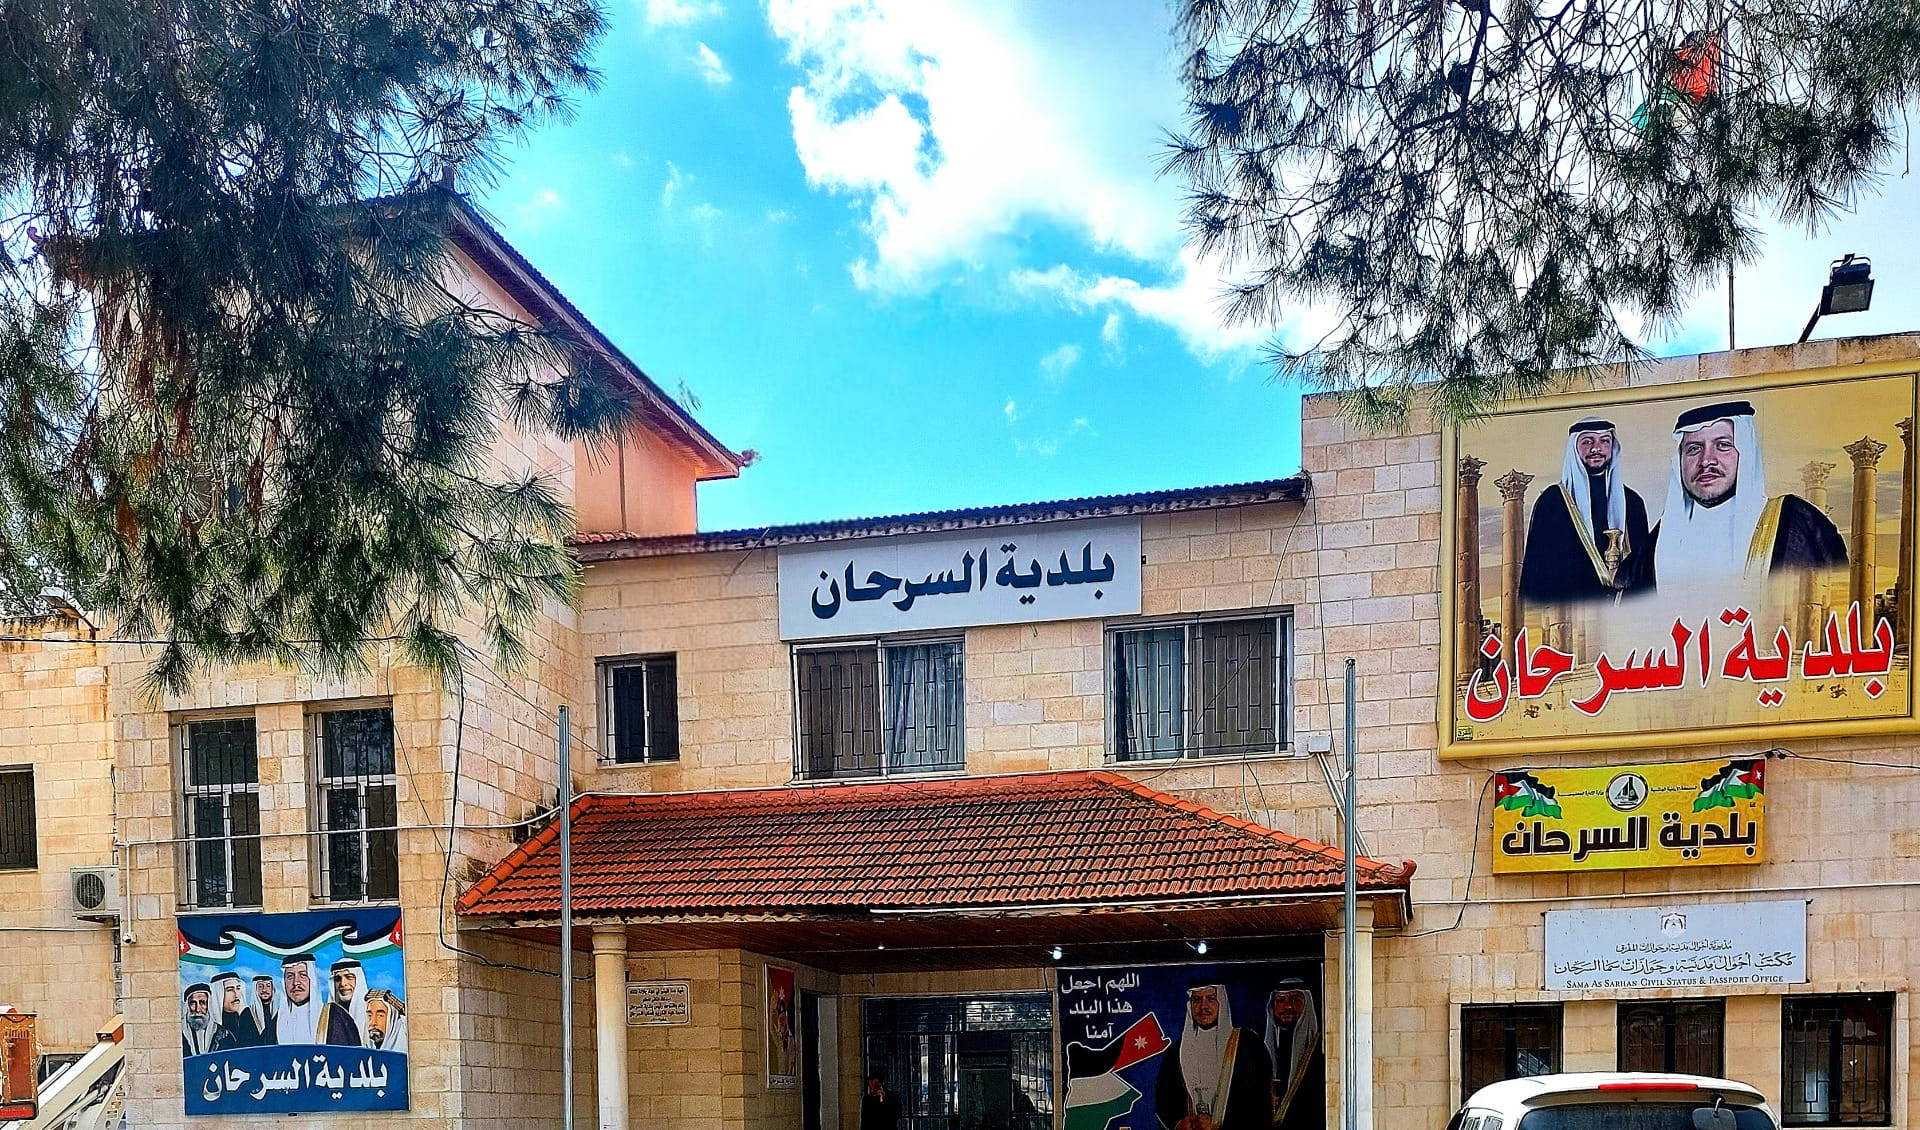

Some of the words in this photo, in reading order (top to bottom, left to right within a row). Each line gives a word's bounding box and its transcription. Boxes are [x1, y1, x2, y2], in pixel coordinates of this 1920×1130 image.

[811, 546, 988, 619] السرحان
[995, 540, 1115, 605] بلدية
[1719, 601, 1895, 708] بلدية
[1464, 615, 1711, 723] السرحان
[1502, 815, 1649, 862] السرحان
[1659, 811, 1757, 859] بلدية
[1554, 959, 1601, 975] السرحان
[1602, 959, 1620, 972] سما
[1675, 955, 1715, 973] مدنية
[1715, 952, 1752, 972] أحوال
[1755, 952, 1796, 970] مكتب
[1061, 974, 1101, 994] اجعل
[1105, 972, 1140, 995] اللهم
[1699, 976, 1706, 985] &
[1069, 999, 1102, 1019] البلد
[1107, 998, 1133, 1014] هذا
[1085, 1022, 1114, 1039] آمنا
[203, 1058, 310, 1101] السرحان
[313, 1054, 388, 1099] بلدية
